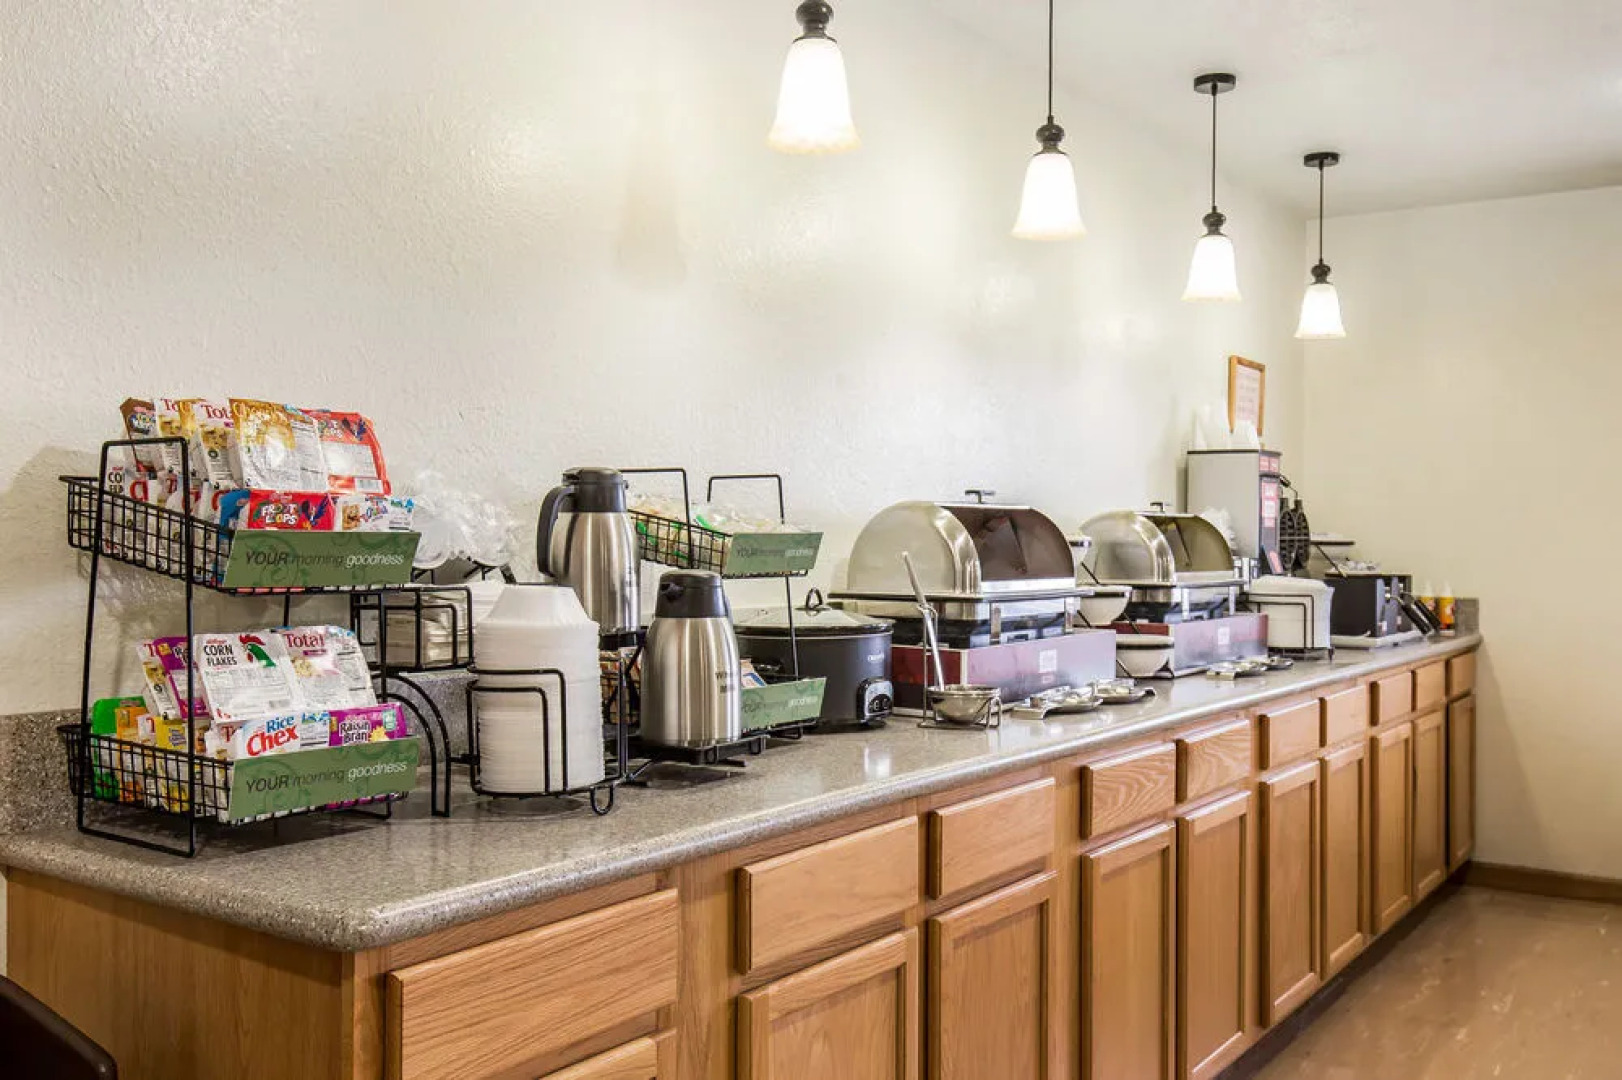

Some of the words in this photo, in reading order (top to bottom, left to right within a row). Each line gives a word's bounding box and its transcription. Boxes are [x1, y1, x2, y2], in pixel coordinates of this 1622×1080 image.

[245, 552, 288, 565] YOUR
[292, 555, 345, 568] morning
[346, 552, 404, 568] goodness
[284, 633, 326, 648] Total
[203, 644, 234, 656] CORN
[206, 656, 238, 667] FLAKES
[266, 715, 295, 733] Rice
[340, 720, 370, 733] Raisin
[246, 724, 300, 757] Chex
[343, 731, 367, 743] Bran
[246, 774, 290, 793] YOUR
[292, 769, 346, 787] morning
[347, 761, 408, 783] goodness
